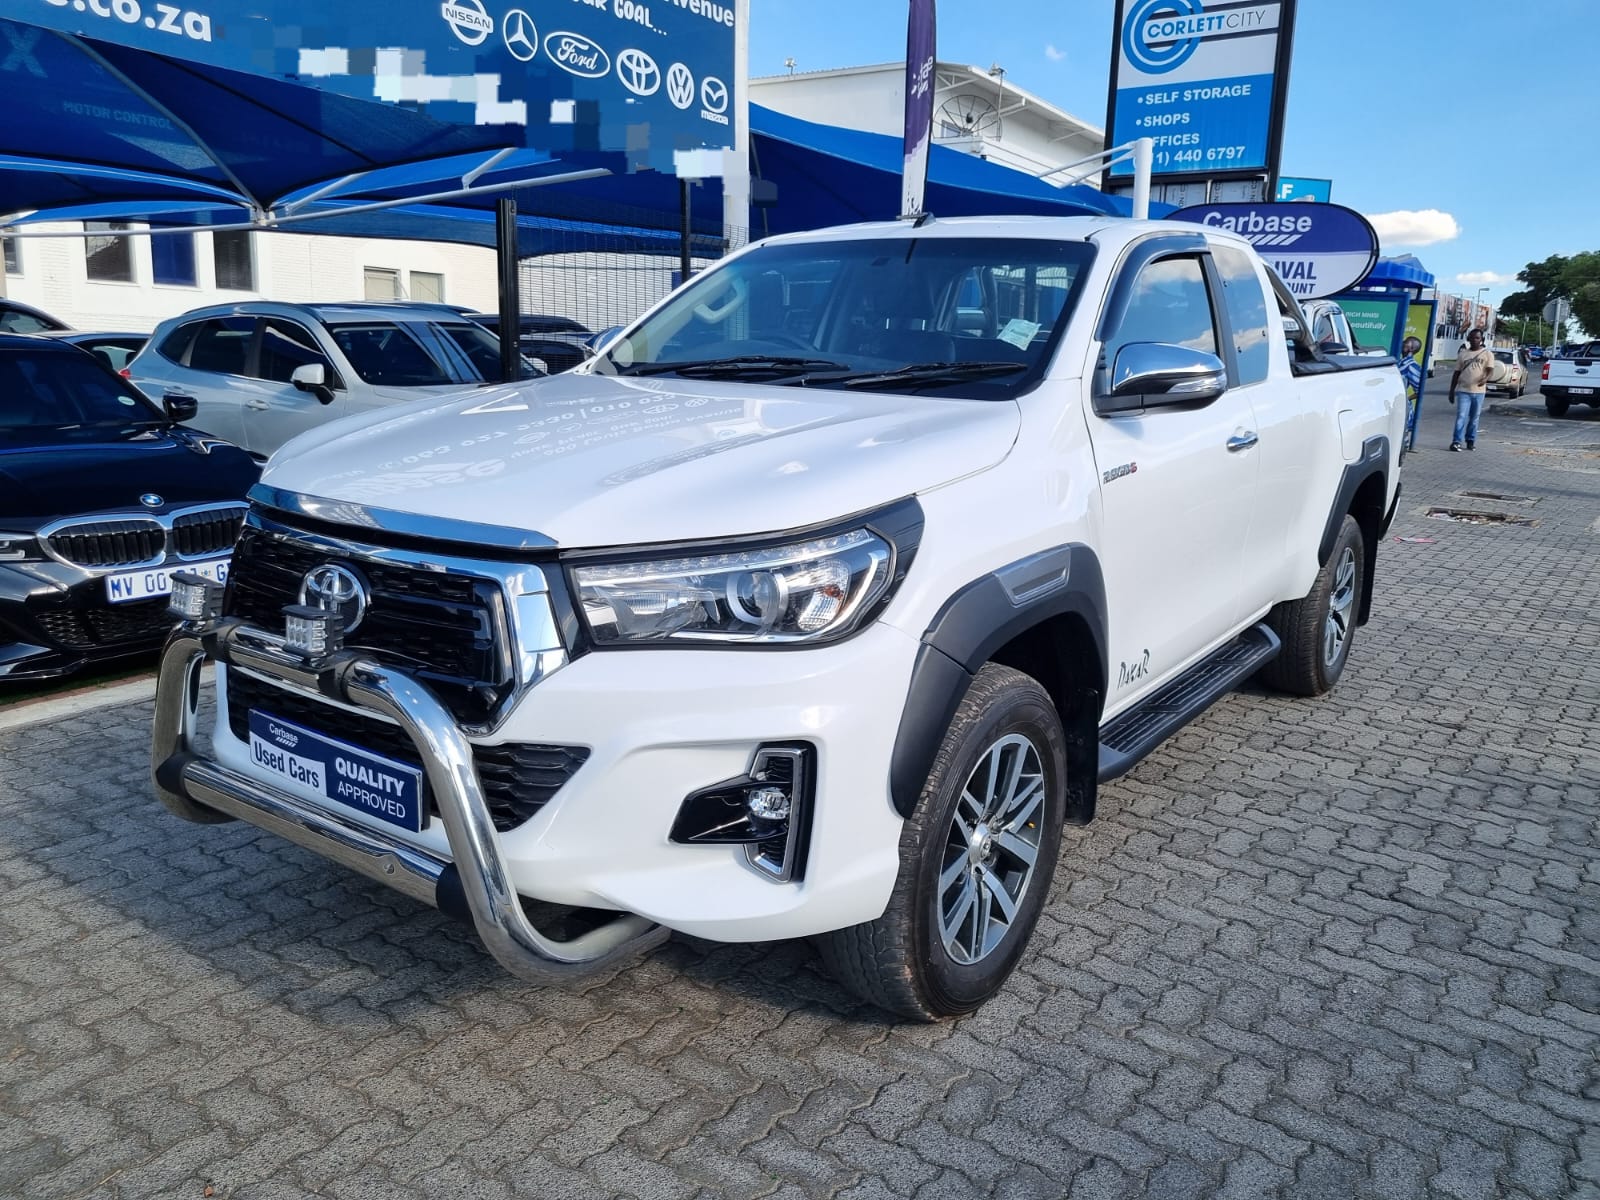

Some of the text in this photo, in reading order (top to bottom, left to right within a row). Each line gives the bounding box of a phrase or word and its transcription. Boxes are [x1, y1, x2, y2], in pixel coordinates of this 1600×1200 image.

[46, 0, 212, 42] .co.za
[445, 7, 491, 29] NISSAN
[664, 0, 734, 27] venue
[557, 37, 599, 71] Ford
[1145, 84, 1252, 105] SELF STORAGE
[63, 101, 174, 130] MOTOR CONTROL
[1143, 112, 1190, 127] SHOPS
[1152, 133, 1200, 148] FFICES
[1174, 149, 1202, 163] 440
[1206, 146, 1246, 161] 6797
[1203, 211, 1313, 233] Carbase
[110, 577, 133, 599] MV
[269, 723, 299, 744] Carbase
[254, 740, 320, 789] Used Cars
[335, 757, 405, 797] QUALITY
[337, 781, 406, 818] APPROVED
